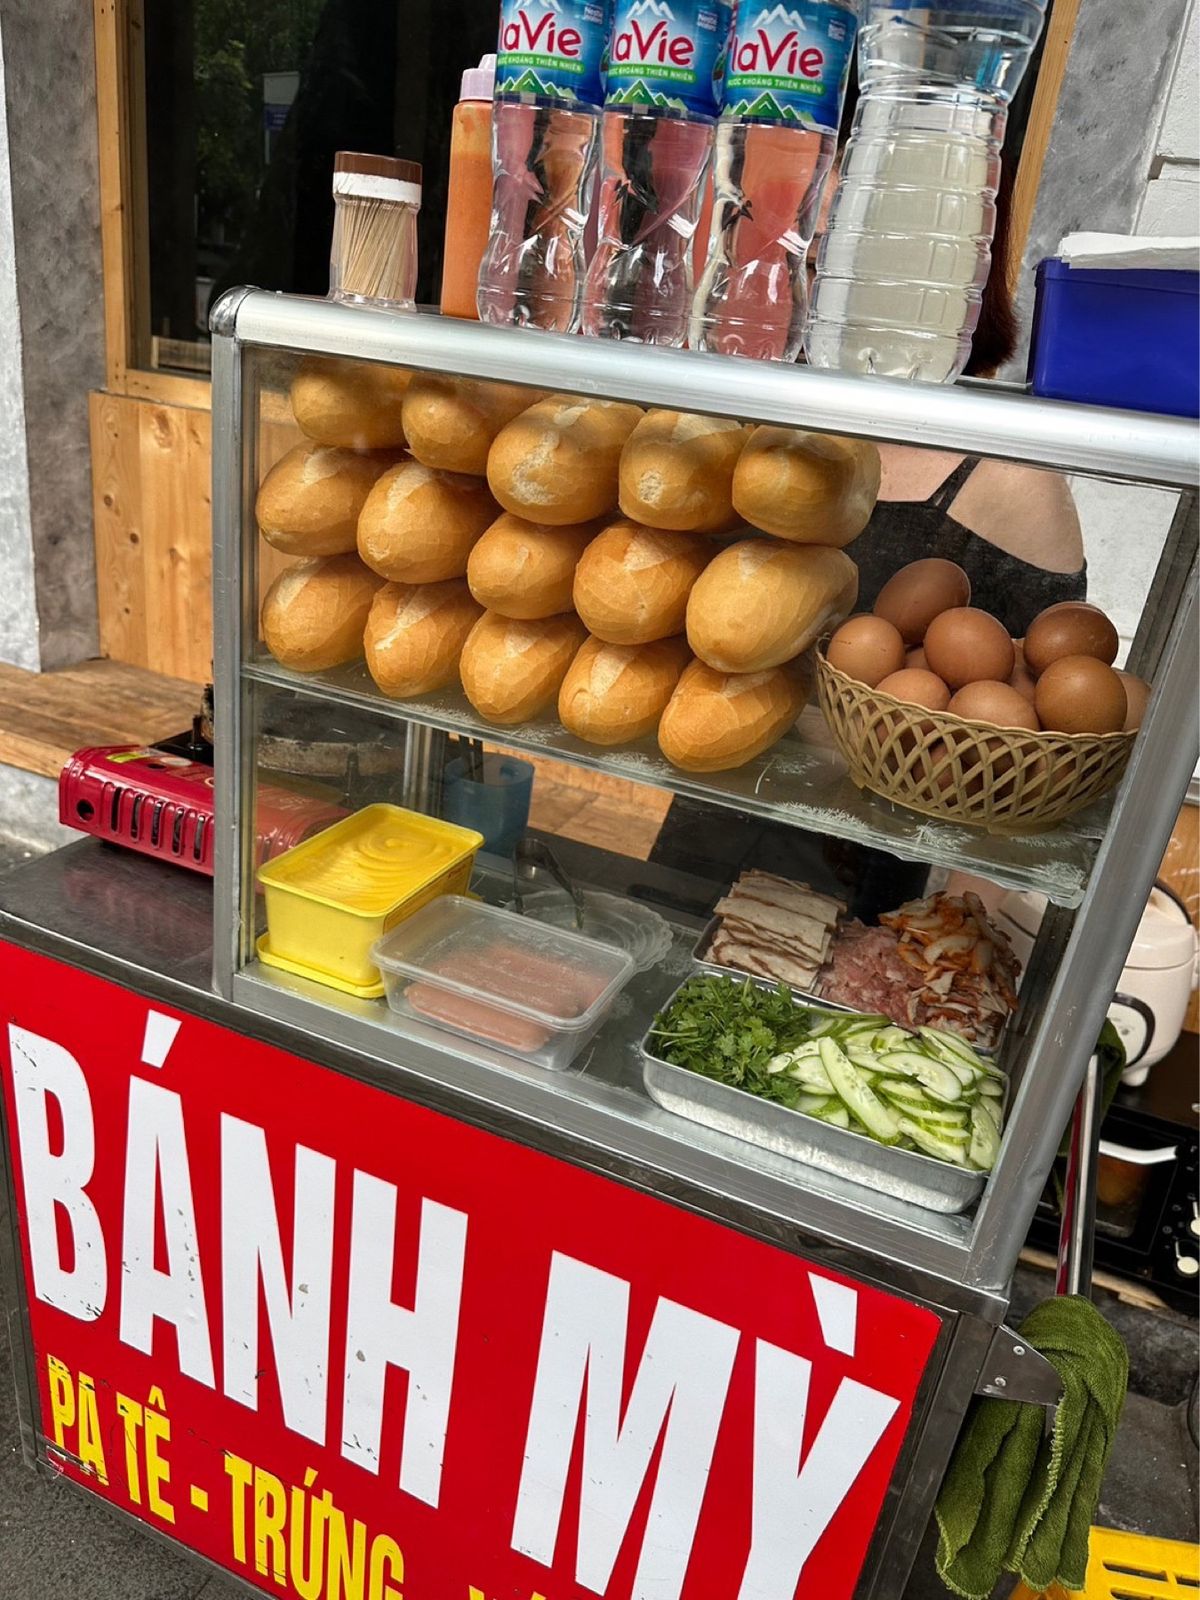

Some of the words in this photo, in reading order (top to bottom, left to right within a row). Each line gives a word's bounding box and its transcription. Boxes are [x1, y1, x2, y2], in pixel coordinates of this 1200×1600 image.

[731, 28, 824, 78] laVie
[8, 1009, 469, 1510] BÁNH
[510, 1249, 902, 1600] MỲ
[47, 1353, 109, 1486] PA
[116, 1384, 176, 1525] TÊ
